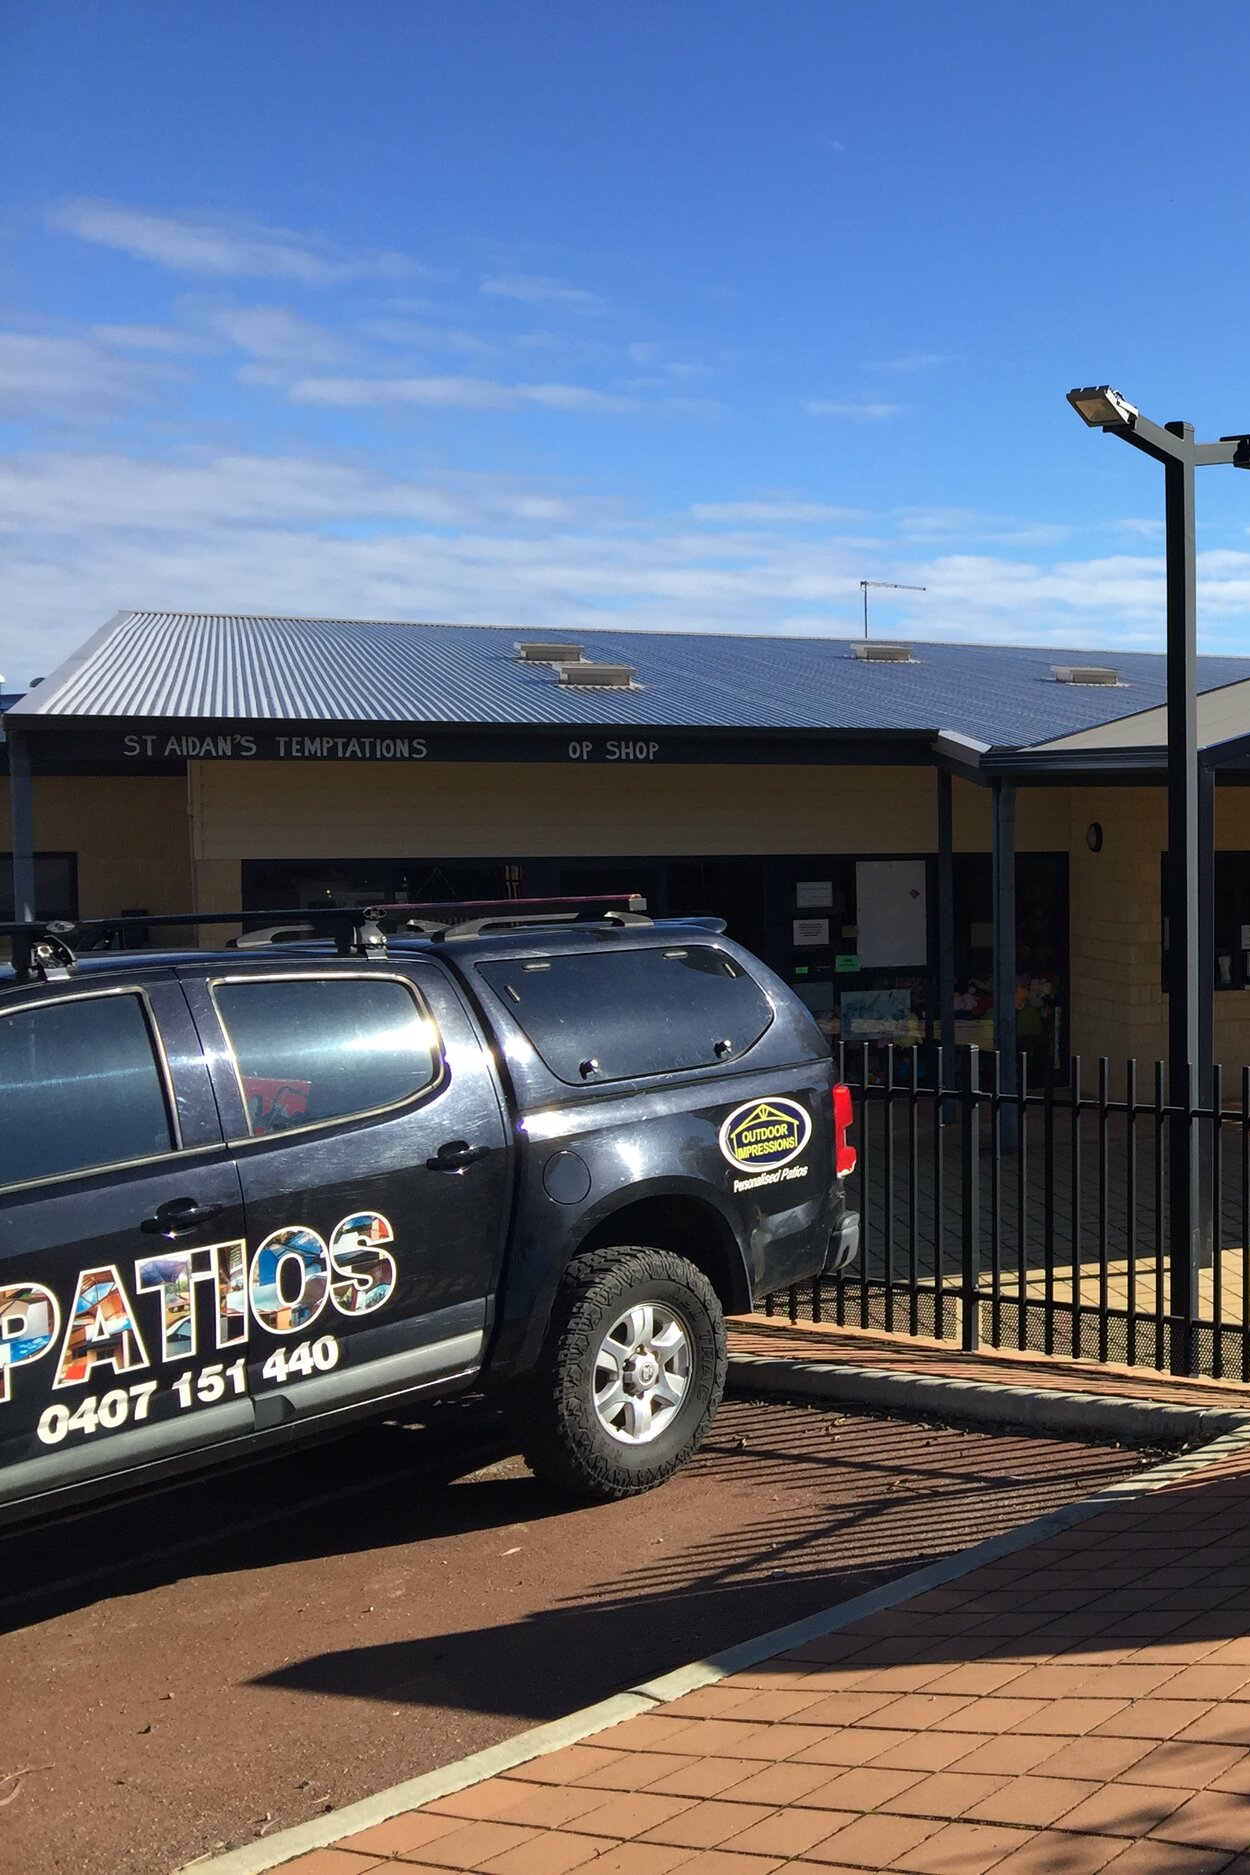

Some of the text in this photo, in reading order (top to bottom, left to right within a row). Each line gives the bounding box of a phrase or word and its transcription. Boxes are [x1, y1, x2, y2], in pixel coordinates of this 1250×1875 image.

[123, 734, 428, 759] ST AIDAN'S TEMPTATIONS
[568, 741, 659, 760] OP SHOP
[742, 1123, 789, 1144] OUTDOOR
[736, 1136, 796, 1160] IMPRESSIONS
[733, 1165, 809, 1193] Personalised Patios
[0, 1211, 397, 1402] PATIOS
[37, 1335, 339, 1444] 0407 151 440
